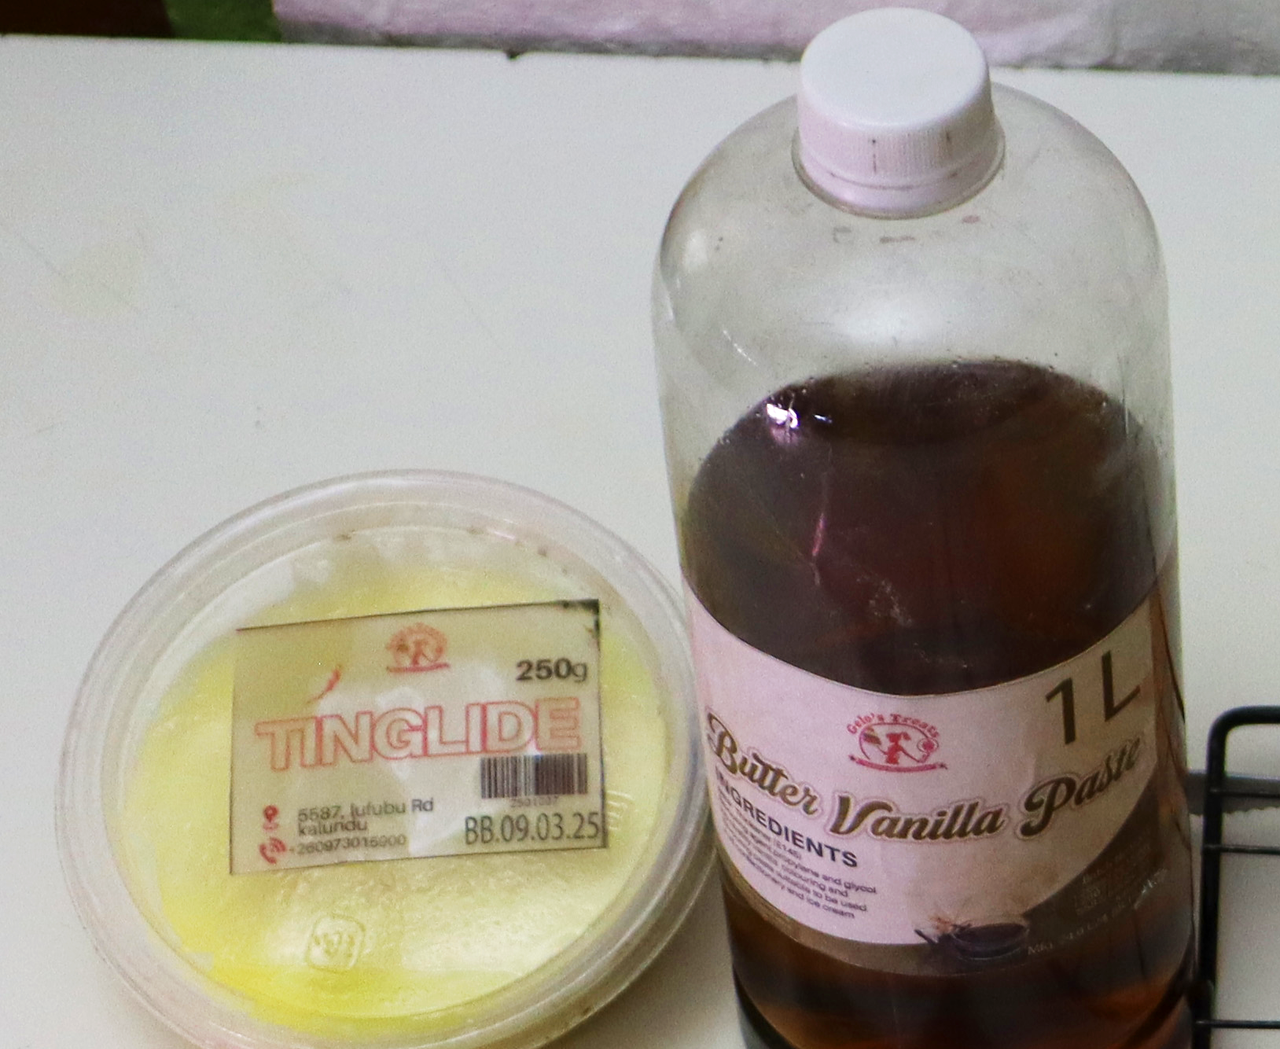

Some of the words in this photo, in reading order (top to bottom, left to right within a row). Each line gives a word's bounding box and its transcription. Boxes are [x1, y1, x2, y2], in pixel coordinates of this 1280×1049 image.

[515, 658, 588, 683] 250g
[254, 696, 582, 772] TINGLIDE
[846, 712, 884, 735] Gelo's
[889, 713, 939, 739] Treats
[706, 711, 820, 816] Butter
[829, 794, 1004, 842] Vanilla
[1020, 737, 1140, 837] Paste
[410, 797, 434, 813] Rd
[715, 766, 858, 868] INGREDIENTS
[465, 811, 600, 845] BB.09.03.25
[822, 874, 842, 886] and
[843, 880, 877, 895] glycol
[828, 886, 849, 898] and
